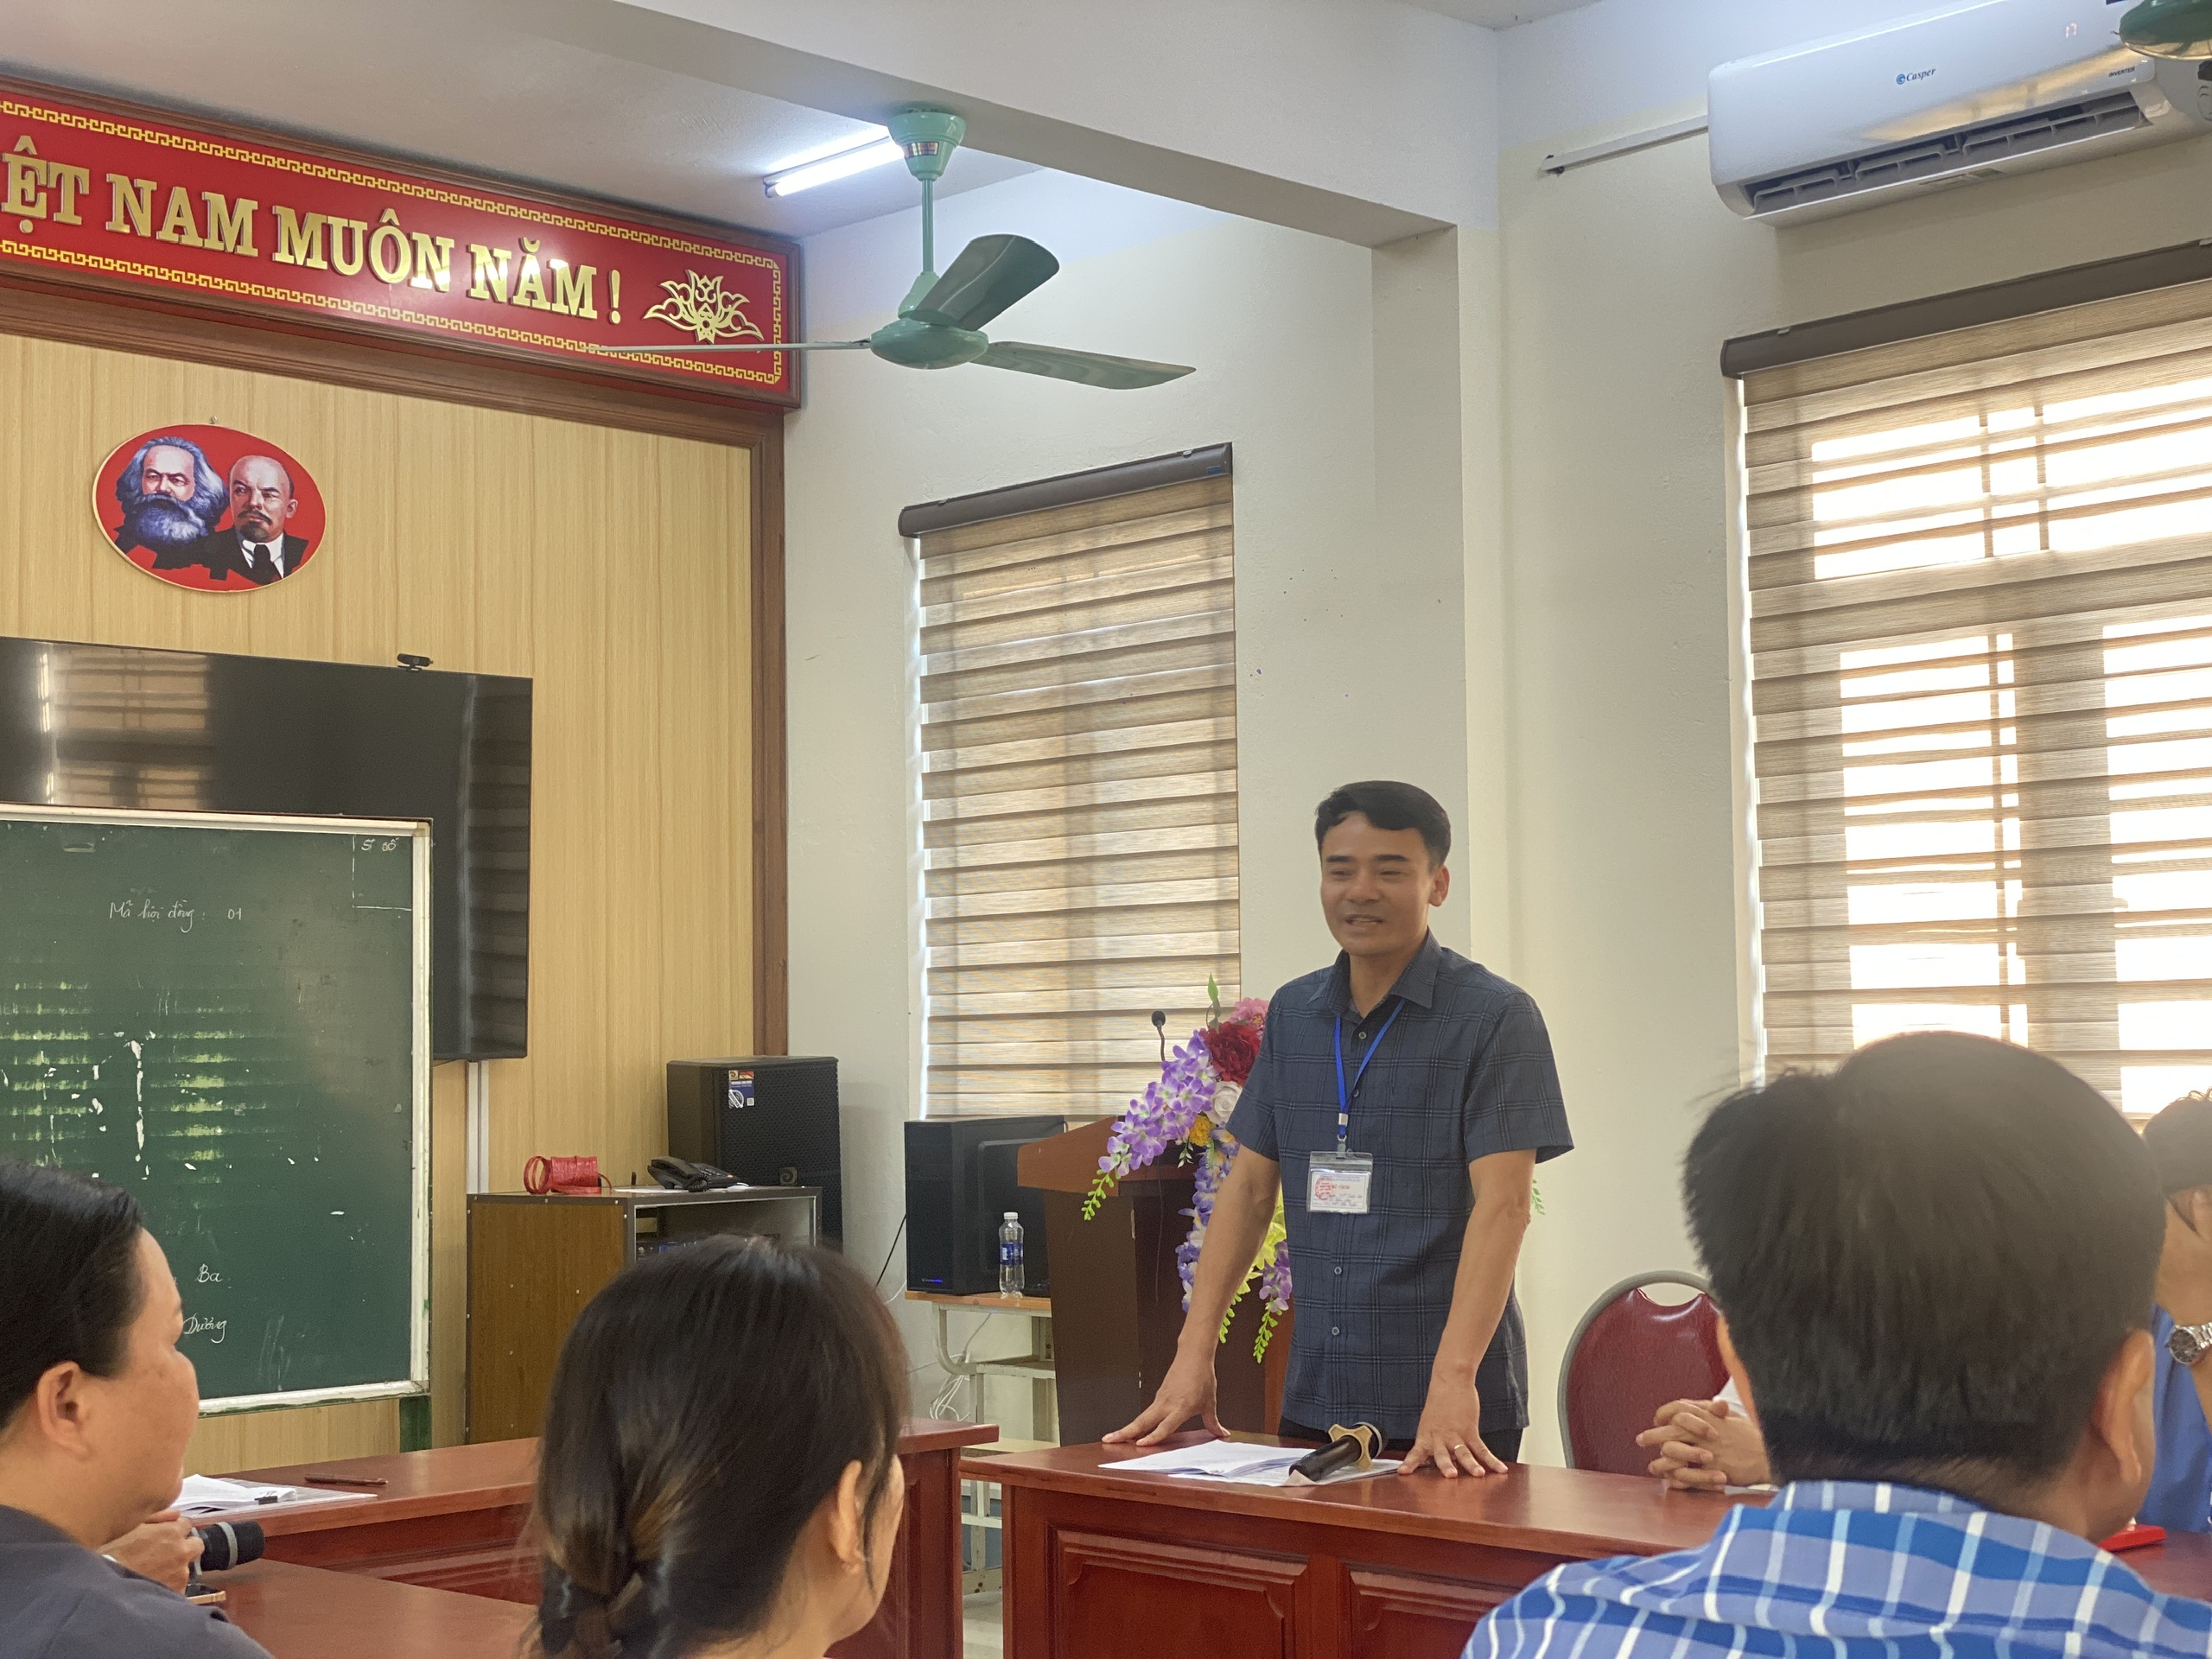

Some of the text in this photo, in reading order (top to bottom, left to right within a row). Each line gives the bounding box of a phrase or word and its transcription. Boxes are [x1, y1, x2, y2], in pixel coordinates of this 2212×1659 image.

[1906, 68, 1936, 81] Casper
[2108, 67, 2136, 78] INVERTER
[1, 135, 90, 234] ỆT
[106, 173, 258, 257] NAM
[272, 205, 454, 292] MUÔN
[467, 236, 598, 320] NĂM
[109, 899, 134, 918] Mã
[138, 899, 164, 923] hội
[227, 907, 242, 920] 01
[194, 1263, 223, 1283] Ba
